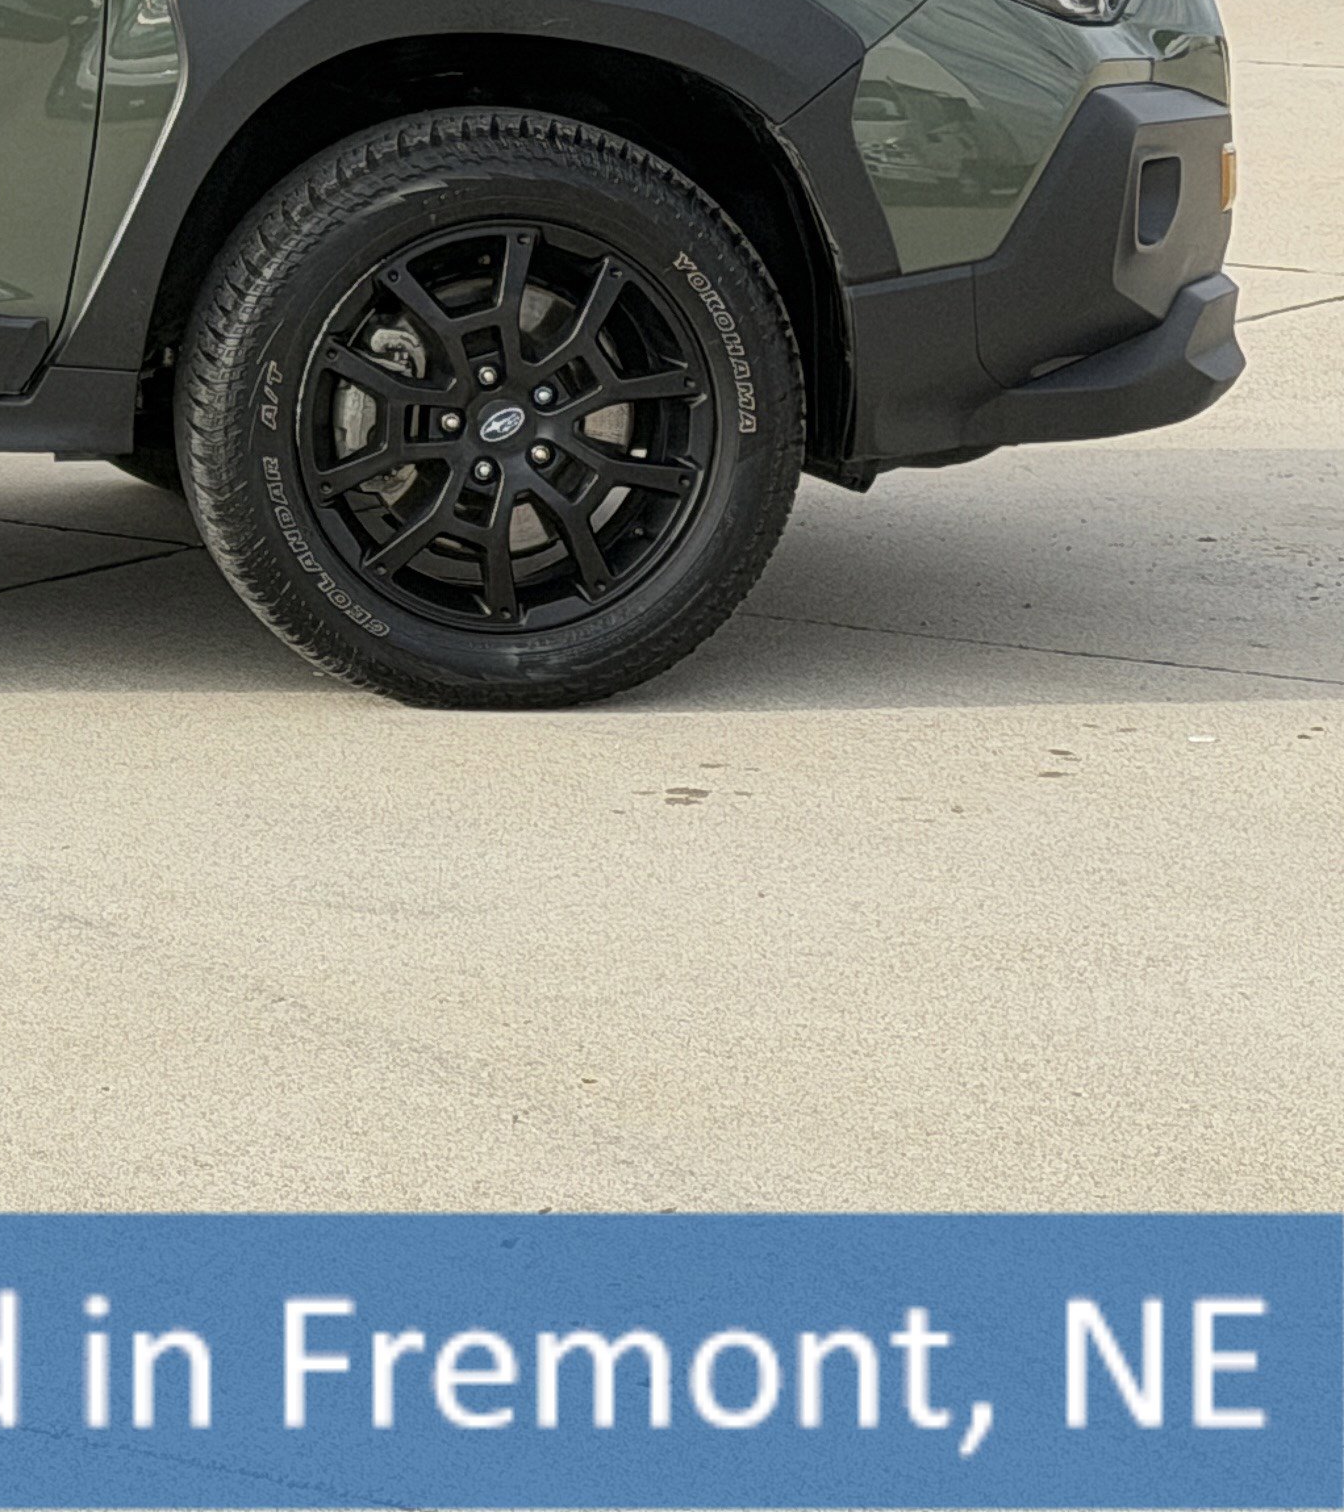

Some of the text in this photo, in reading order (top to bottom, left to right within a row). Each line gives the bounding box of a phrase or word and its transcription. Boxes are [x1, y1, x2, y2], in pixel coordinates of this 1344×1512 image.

[672, 251, 758, 434] YOKOHAMA
[262, 360, 390, 637] GEOLANDAR A/T
